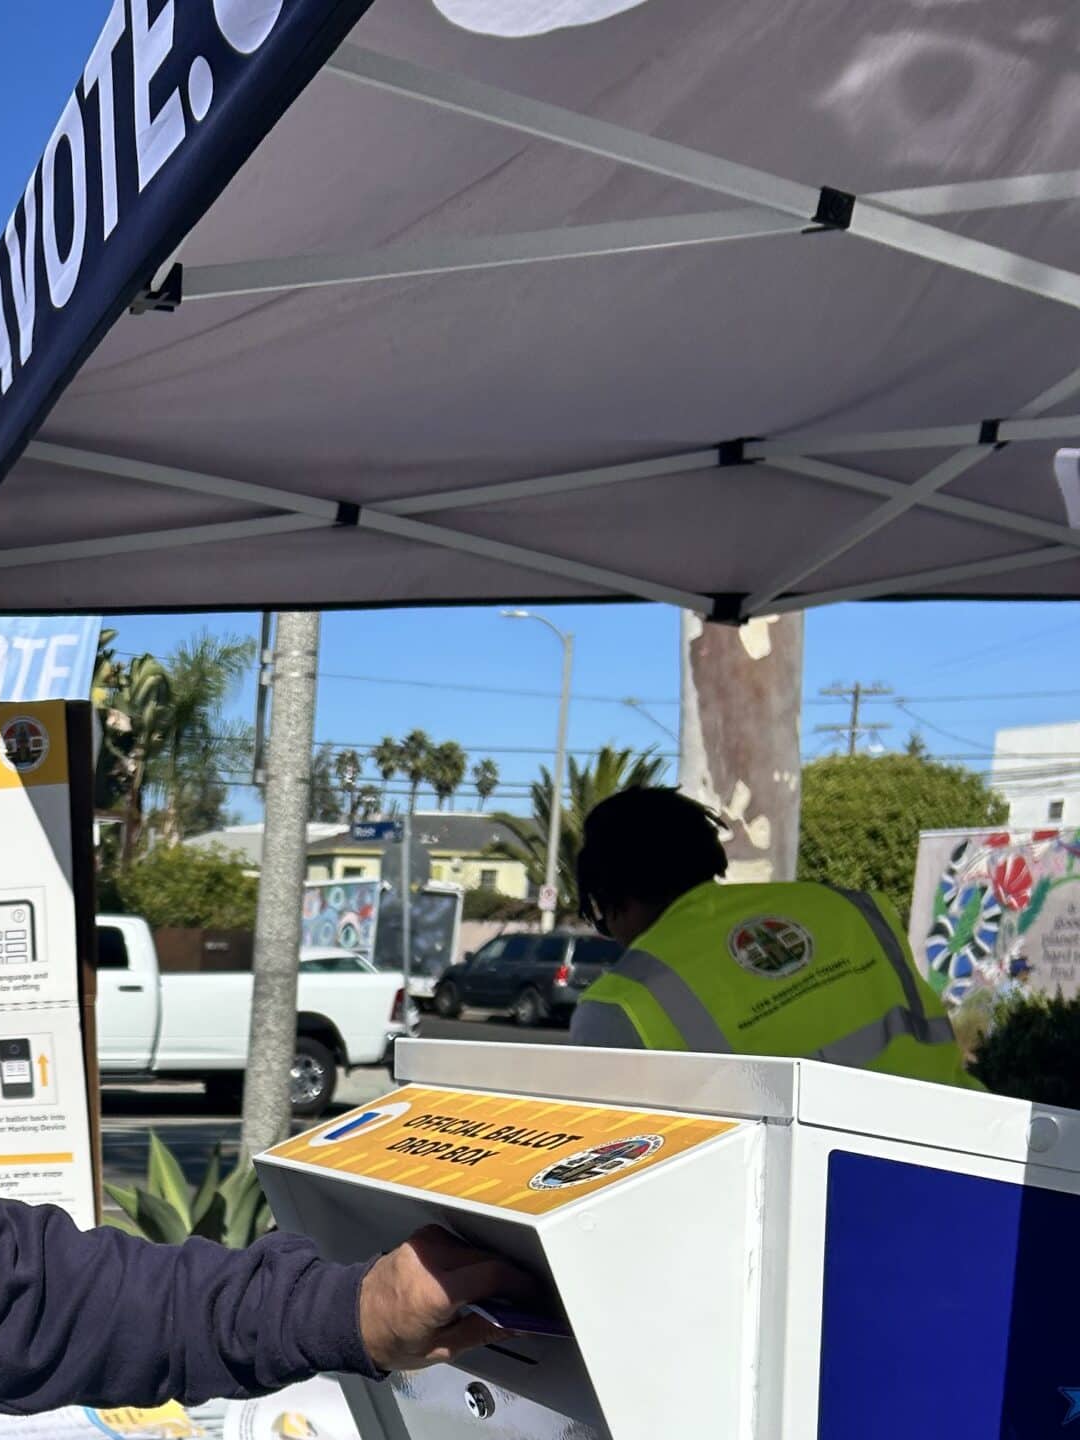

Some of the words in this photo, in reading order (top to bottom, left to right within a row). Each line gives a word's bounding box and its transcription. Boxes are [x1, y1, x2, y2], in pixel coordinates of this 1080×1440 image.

[403, 1114, 495, 1139] OFFICIAL
[480, 1125, 584, 1150] BALLOT
[385, 1136, 450, 1156] DROP
[435, 1145, 500, 1166] BOX
